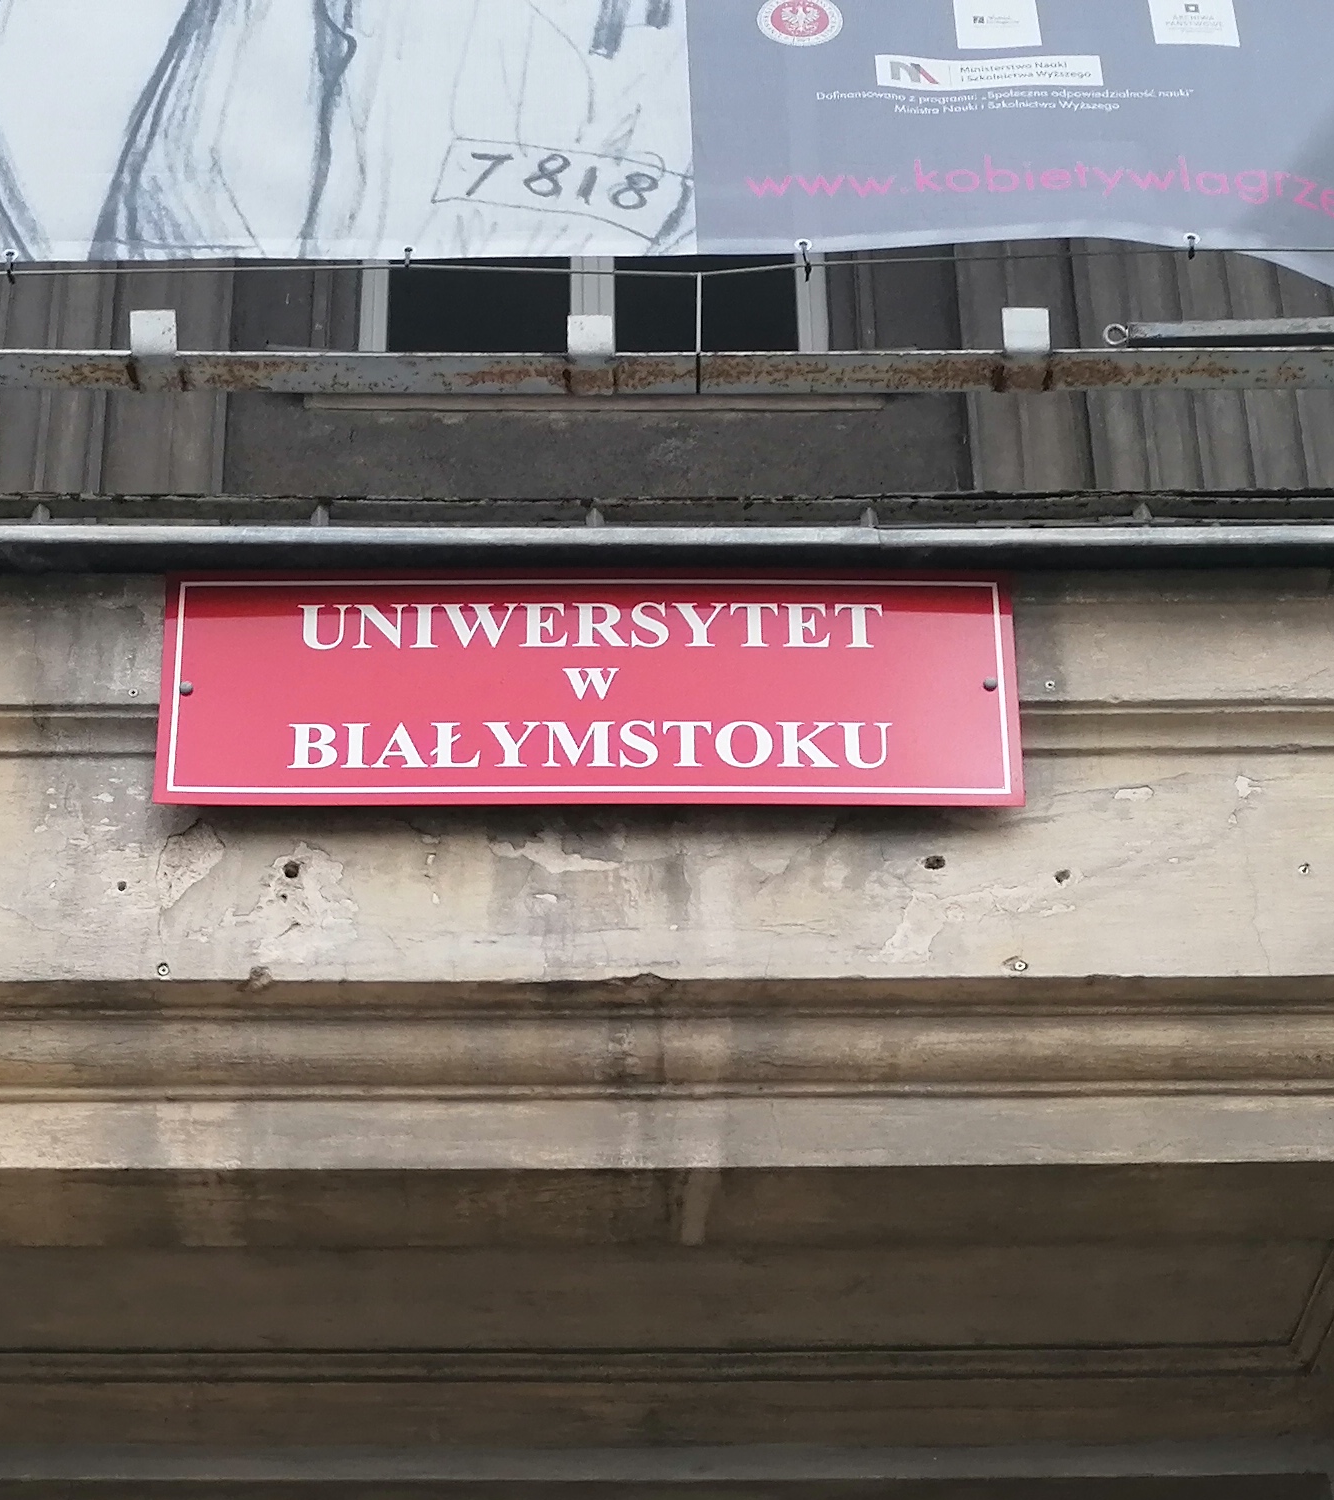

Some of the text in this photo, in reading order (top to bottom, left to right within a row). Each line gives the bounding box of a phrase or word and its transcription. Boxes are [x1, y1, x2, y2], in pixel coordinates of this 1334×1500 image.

[960, 61, 1067, 73] Ministerstwo Nauki
[967, 72, 1034, 81] Szkolnictwa
[1035, 70, 1092, 79] Wyższego
[816, 91, 906, 101] Dofinansowano
[894, 104, 940, 115] Ministra
[942, 103, 978, 113] Nauki
[987, 99, 1056, 110] Szkolnictwa
[1058, 99, 1120, 112] Wyższego
[466, 152, 659, 210] 7818
[300, 602, 883, 650] UNIWERSYTET
[286, 719, 894, 769] BIAŁYMSTOKU
